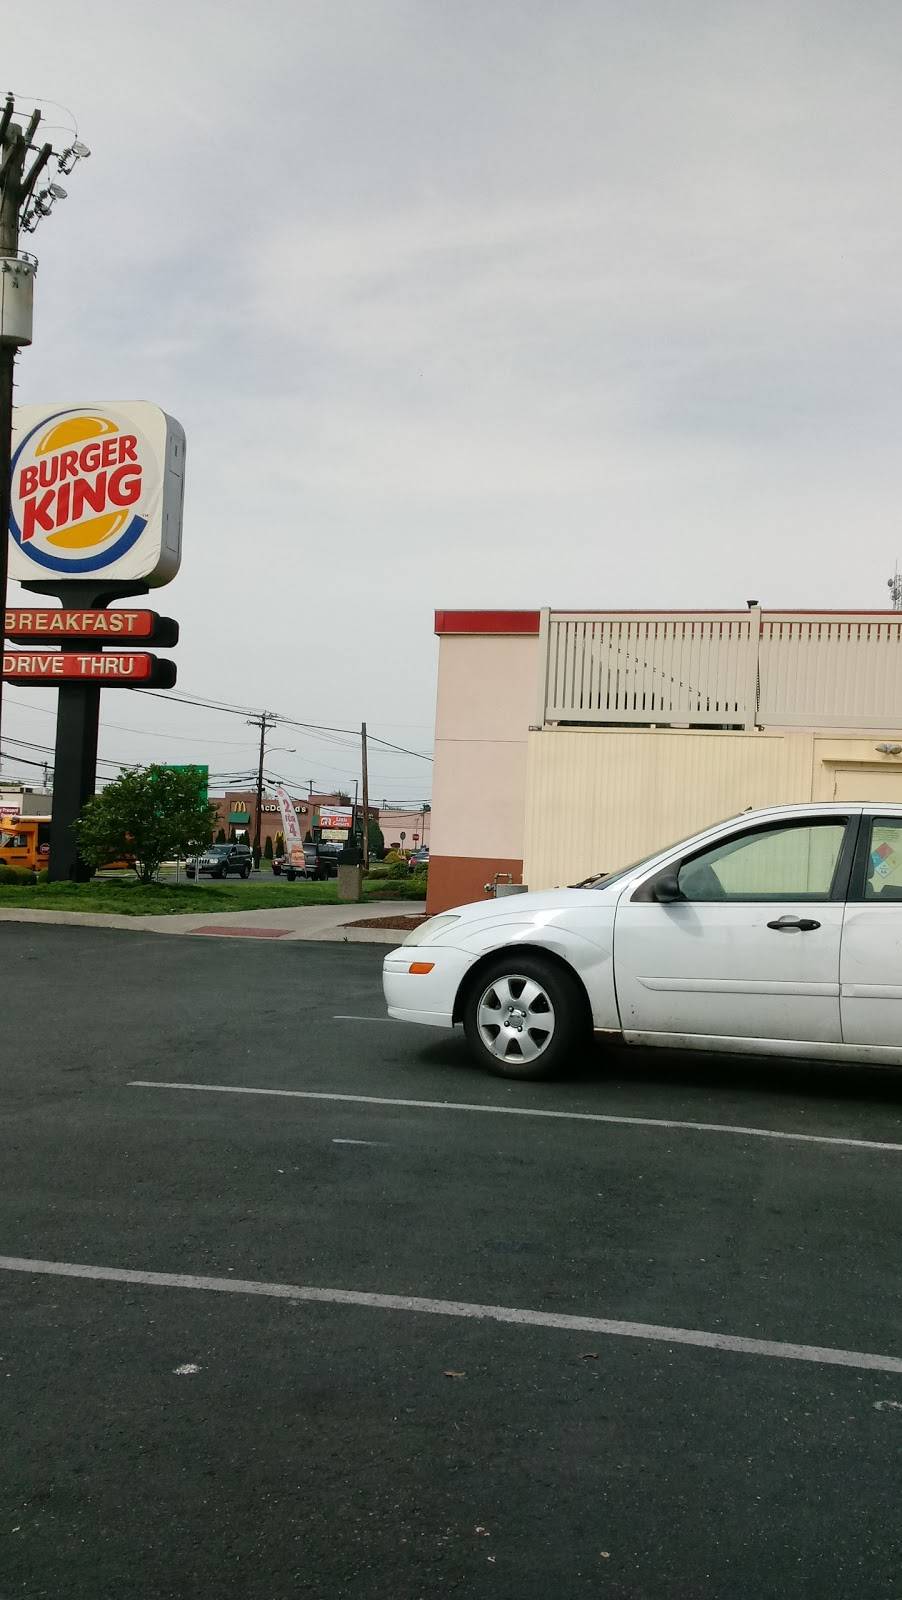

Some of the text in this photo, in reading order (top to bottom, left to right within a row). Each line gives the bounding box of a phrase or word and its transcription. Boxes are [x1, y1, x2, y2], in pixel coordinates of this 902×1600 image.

[18, 434, 138, 499] BURGER
[21, 463, 143, 542] KING
[5, 612, 138, 633] BREAKFAST
[3, 656, 135, 675] DRIVE THRU
